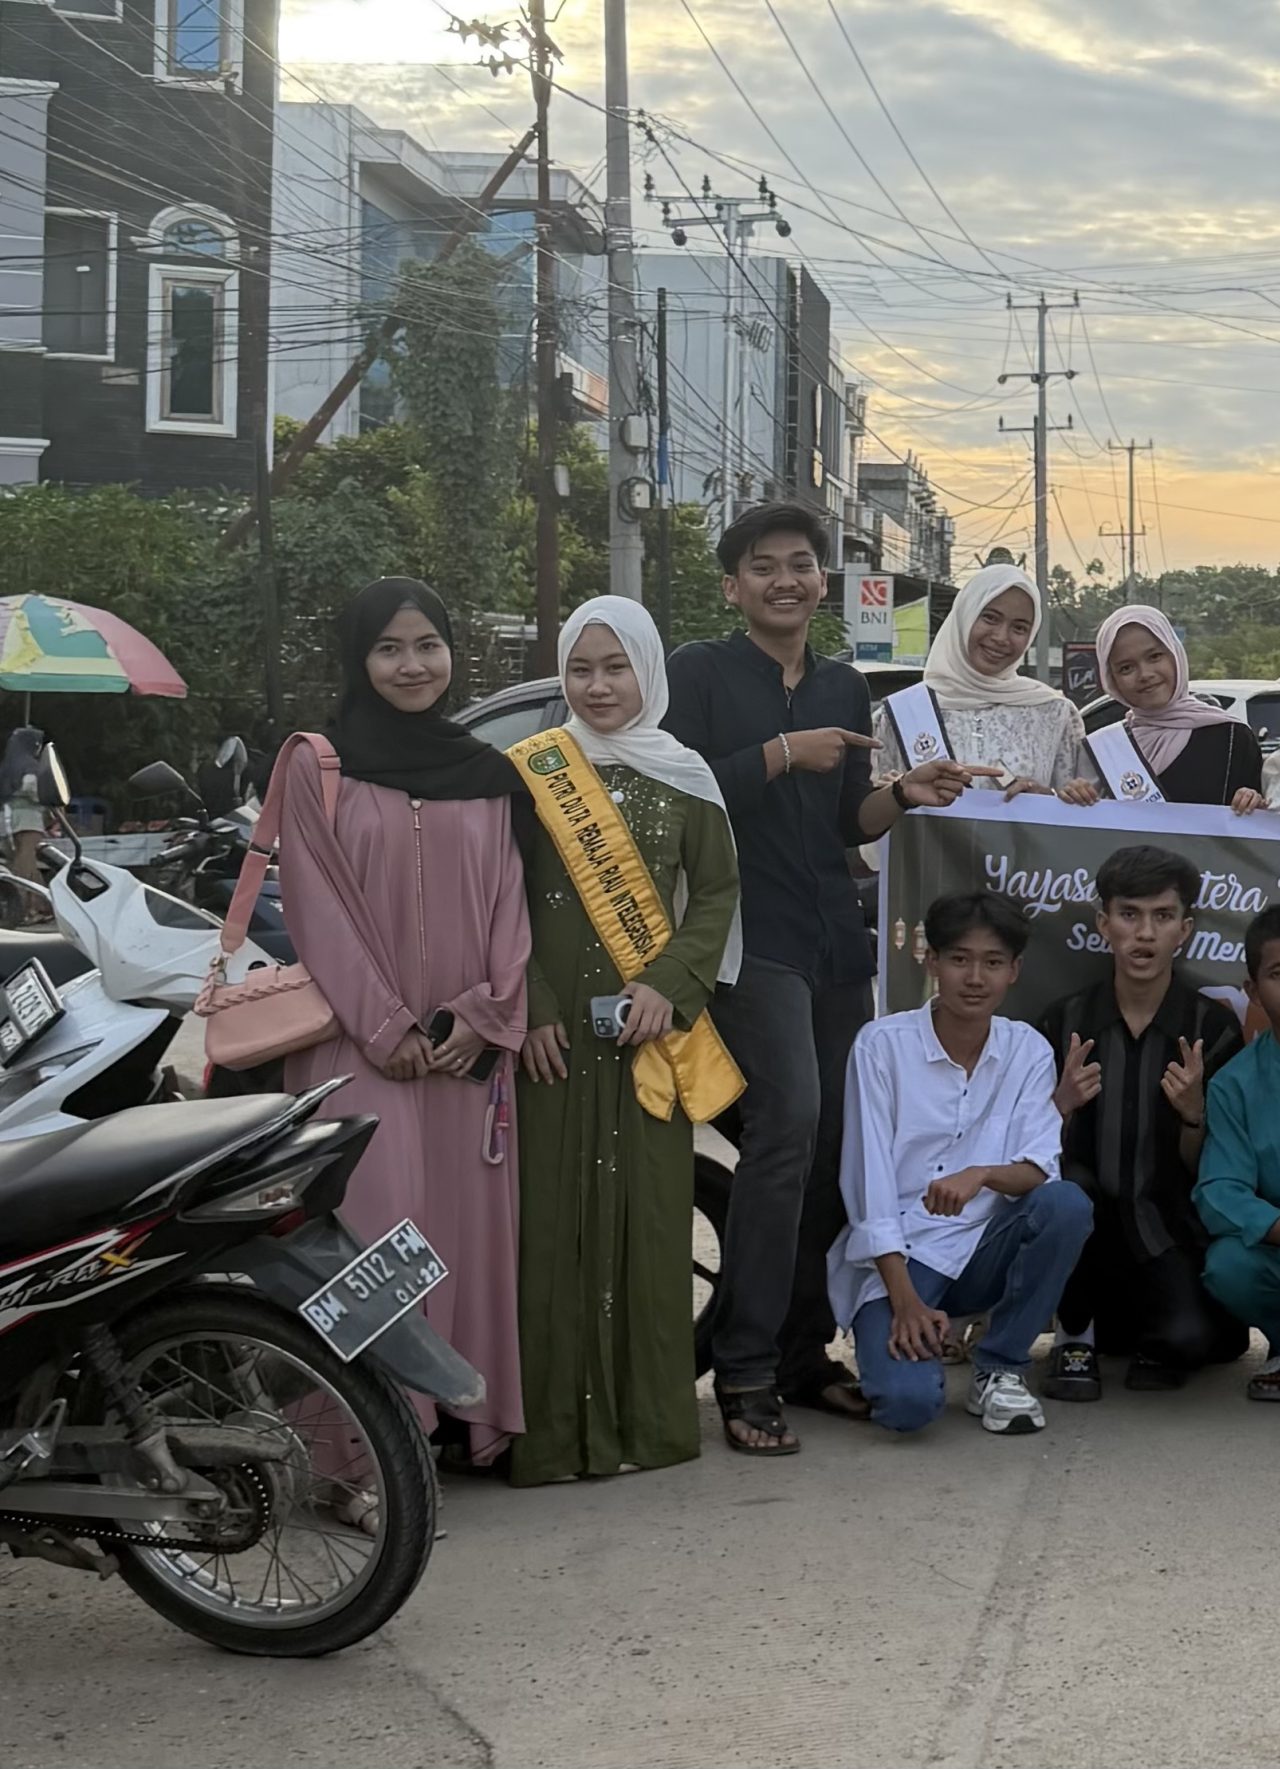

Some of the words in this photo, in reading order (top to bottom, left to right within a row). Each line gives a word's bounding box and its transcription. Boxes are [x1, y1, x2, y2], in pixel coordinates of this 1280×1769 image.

[861, 611, 887, 624] BNI
[546, 772, 577, 802] PUTRI
[560, 796, 592, 827] DUTA
[575, 821, 613, 870] REMAJA
[596, 864, 627, 894] RIAU
[307, 1290, 349, 1334] BM
[344, 1252, 396, 1300] 5112
